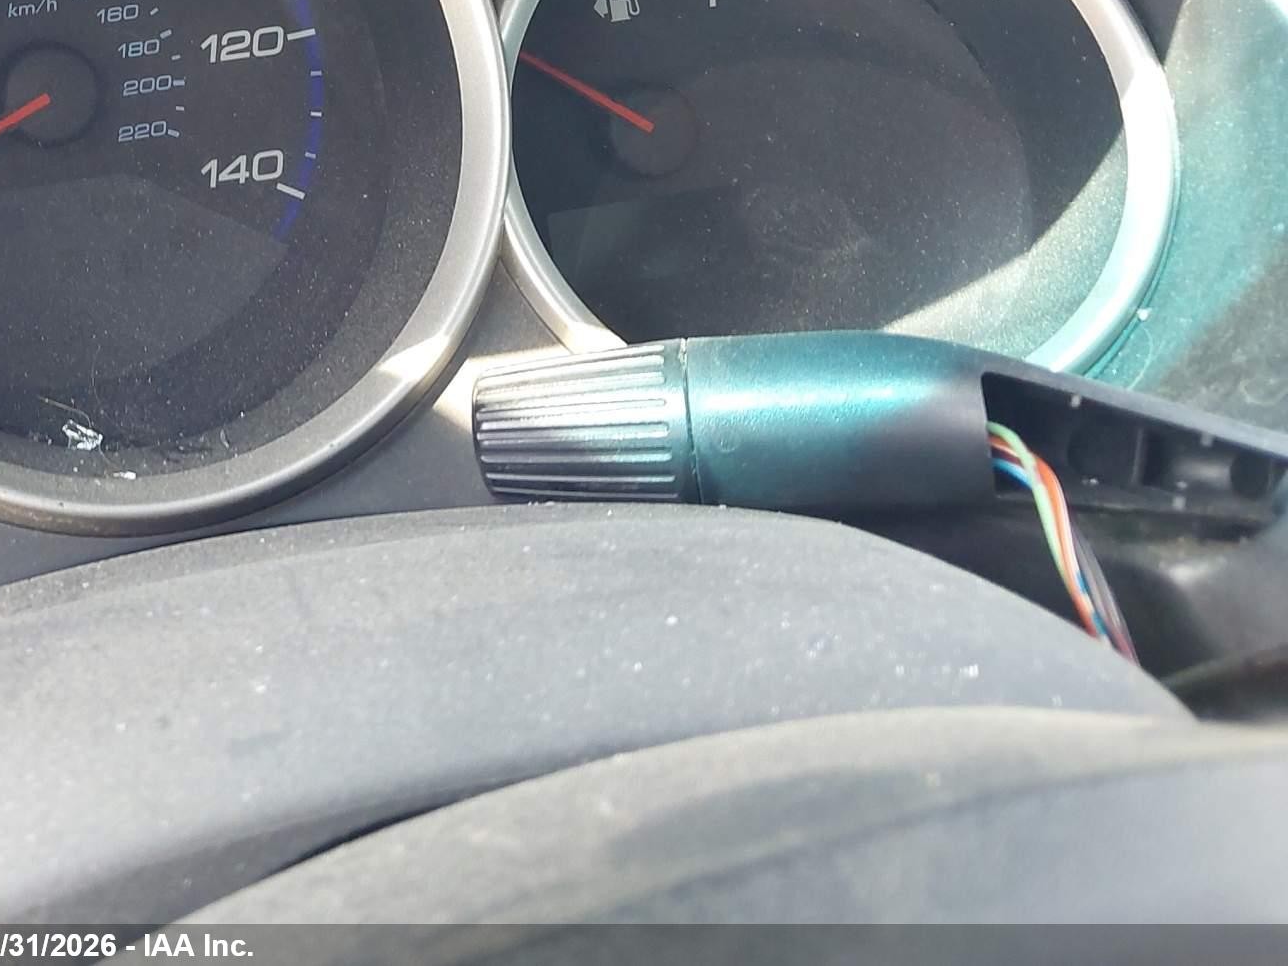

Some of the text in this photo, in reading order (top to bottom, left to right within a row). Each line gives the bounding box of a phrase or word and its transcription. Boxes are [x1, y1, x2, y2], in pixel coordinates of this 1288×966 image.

[96, 3, 139, 24] 160
[117, 37, 160, 59] 180
[200, 25, 284, 62] 120
[122, 74, 172, 96] 200
[117, 120, 167, 142] 220
[200, 149, 283, 187] 140
